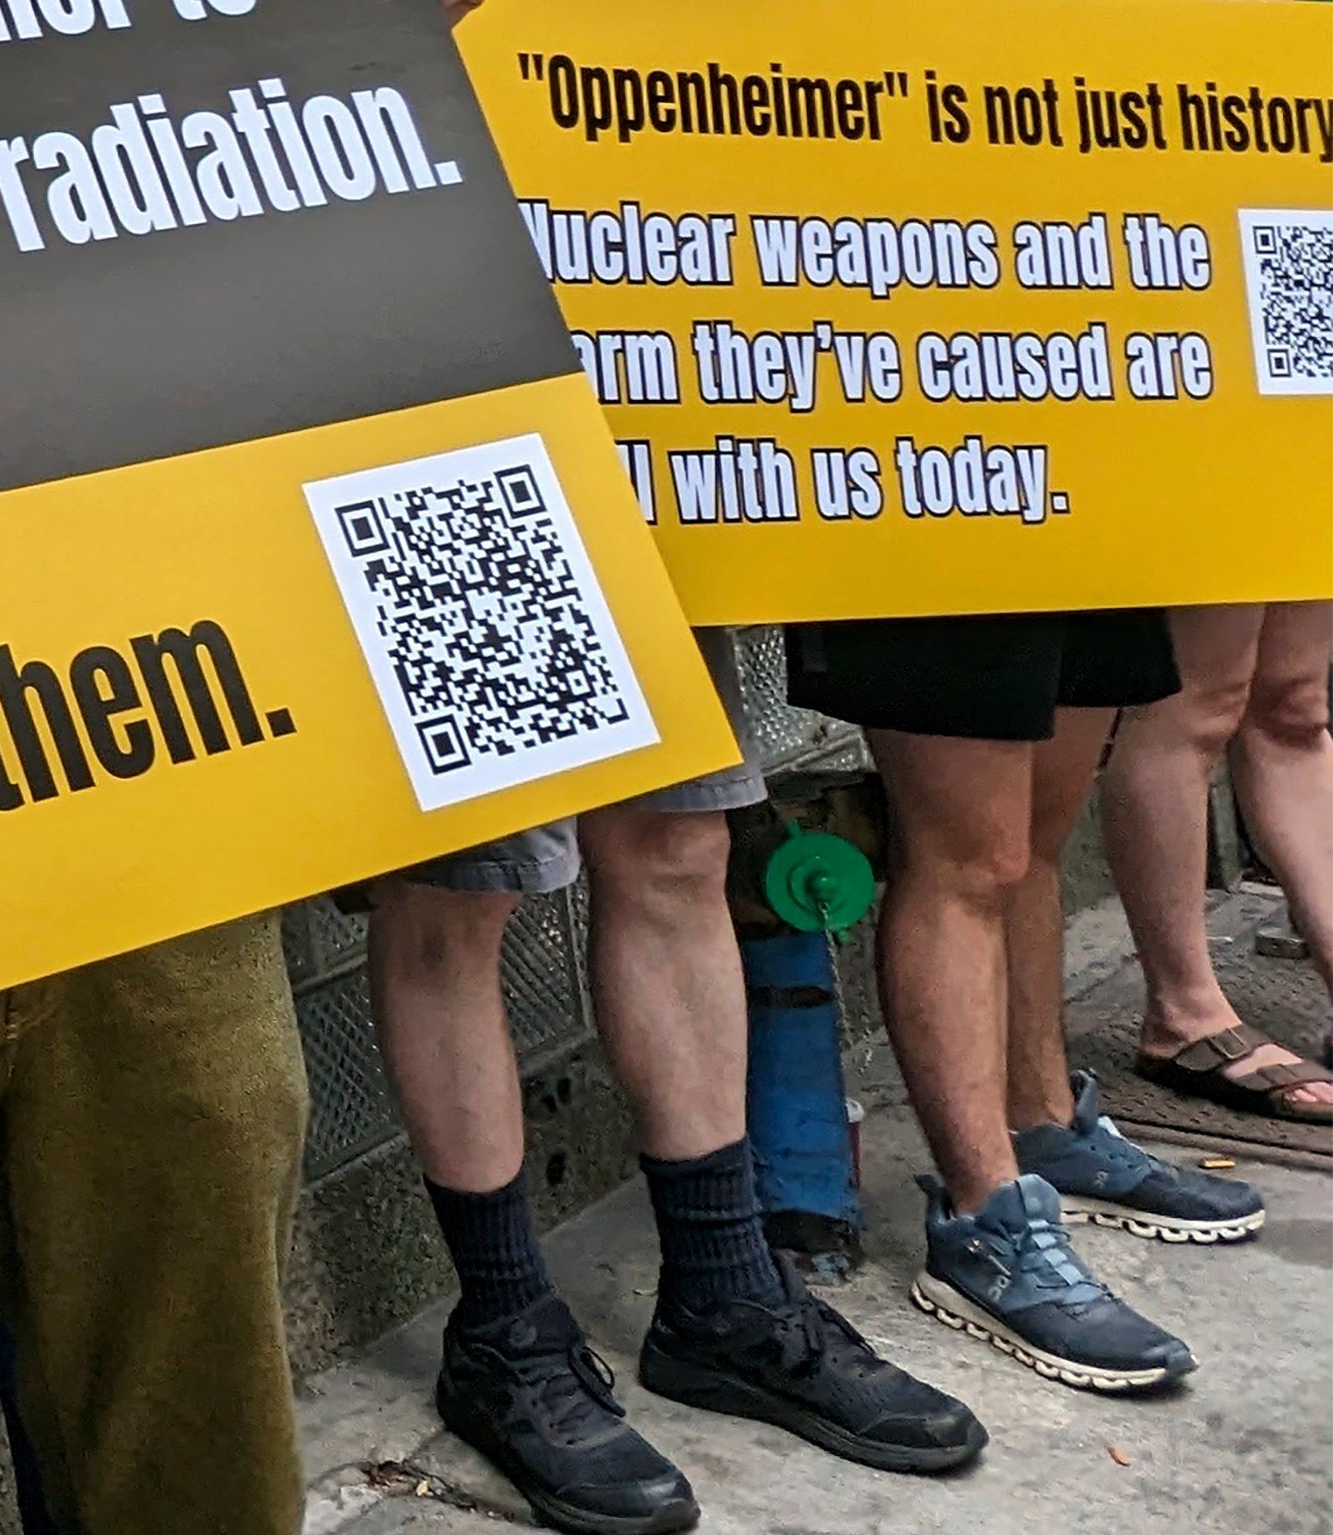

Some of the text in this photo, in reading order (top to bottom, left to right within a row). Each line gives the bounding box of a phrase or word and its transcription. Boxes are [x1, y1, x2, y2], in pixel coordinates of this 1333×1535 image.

[517, 52, 1333, 163] "Oppenheimer" is not just history
[750, 216, 1001, 299] weapons
[1012, 213, 1115, 289] and
[1121, 213, 1213, 291] the
[571, 321, 1214, 412] arm they've caused are
[668, 436, 800, 523] with
[810, 448, 885, 520] us
[893, 436, 1070, 524] today.
